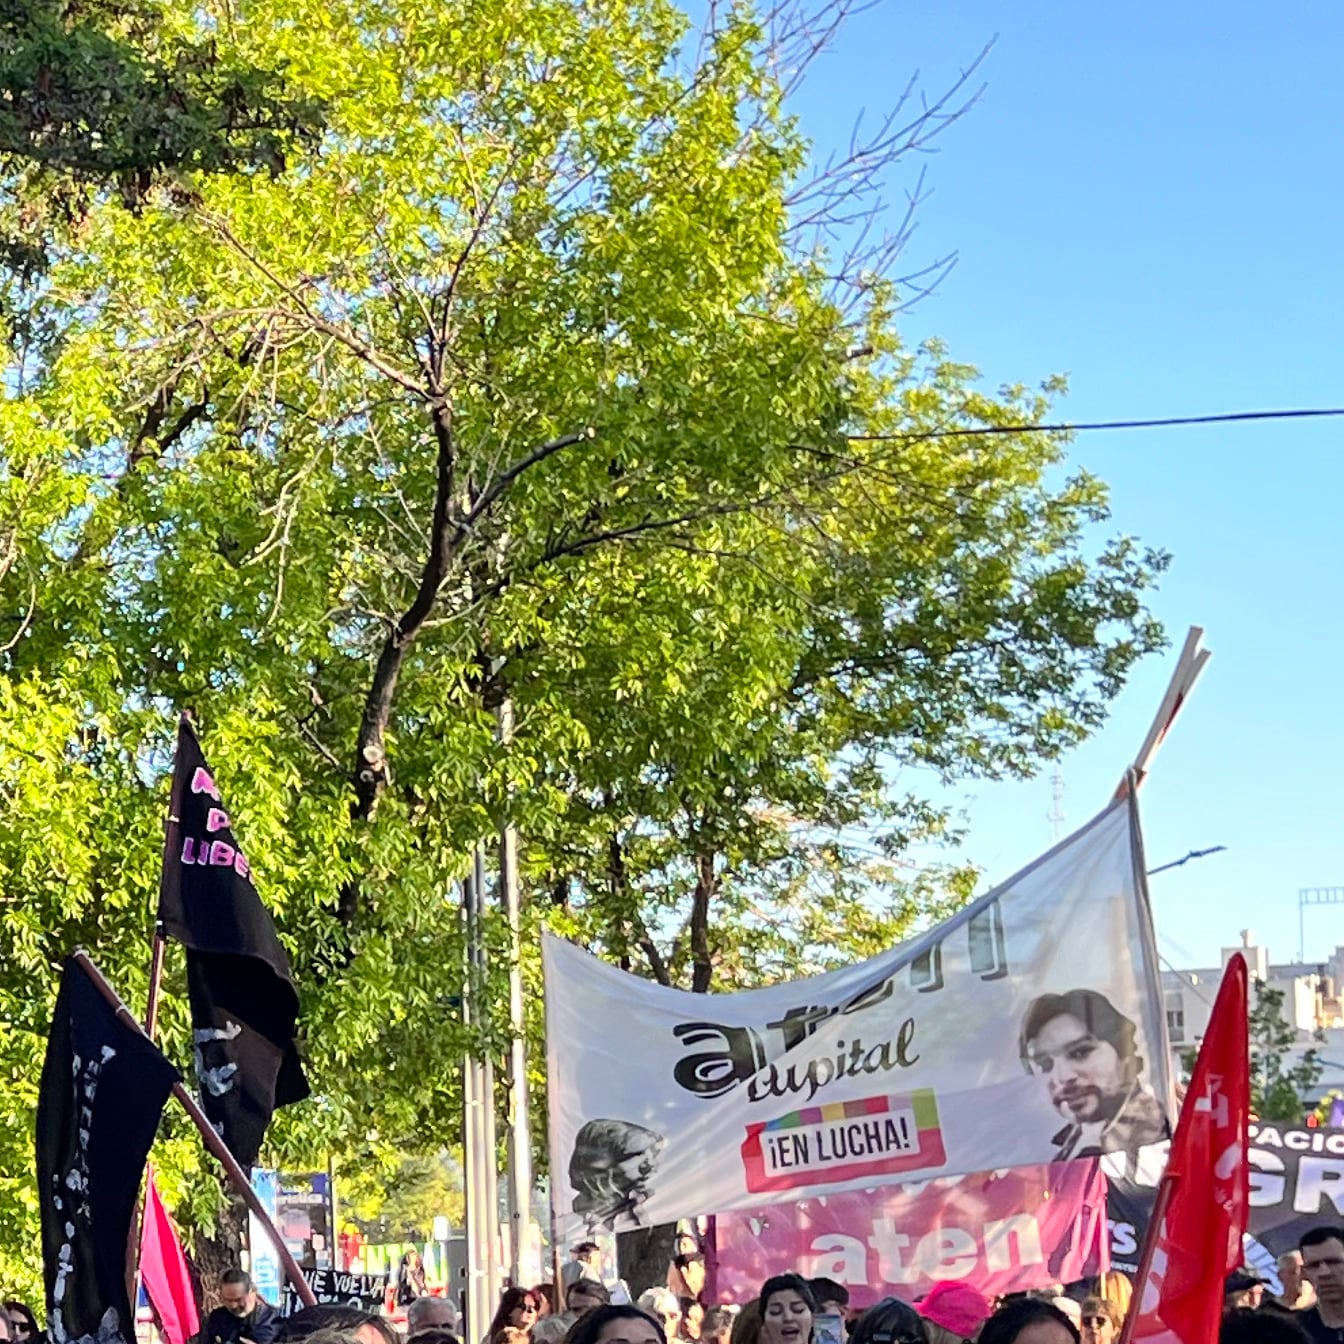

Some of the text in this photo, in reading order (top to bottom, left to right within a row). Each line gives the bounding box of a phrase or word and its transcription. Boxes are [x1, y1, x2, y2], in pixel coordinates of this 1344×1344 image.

[768, 1116, 911, 1170] ¡EN LUCHA!
[810, 1212, 1044, 1287] aten
